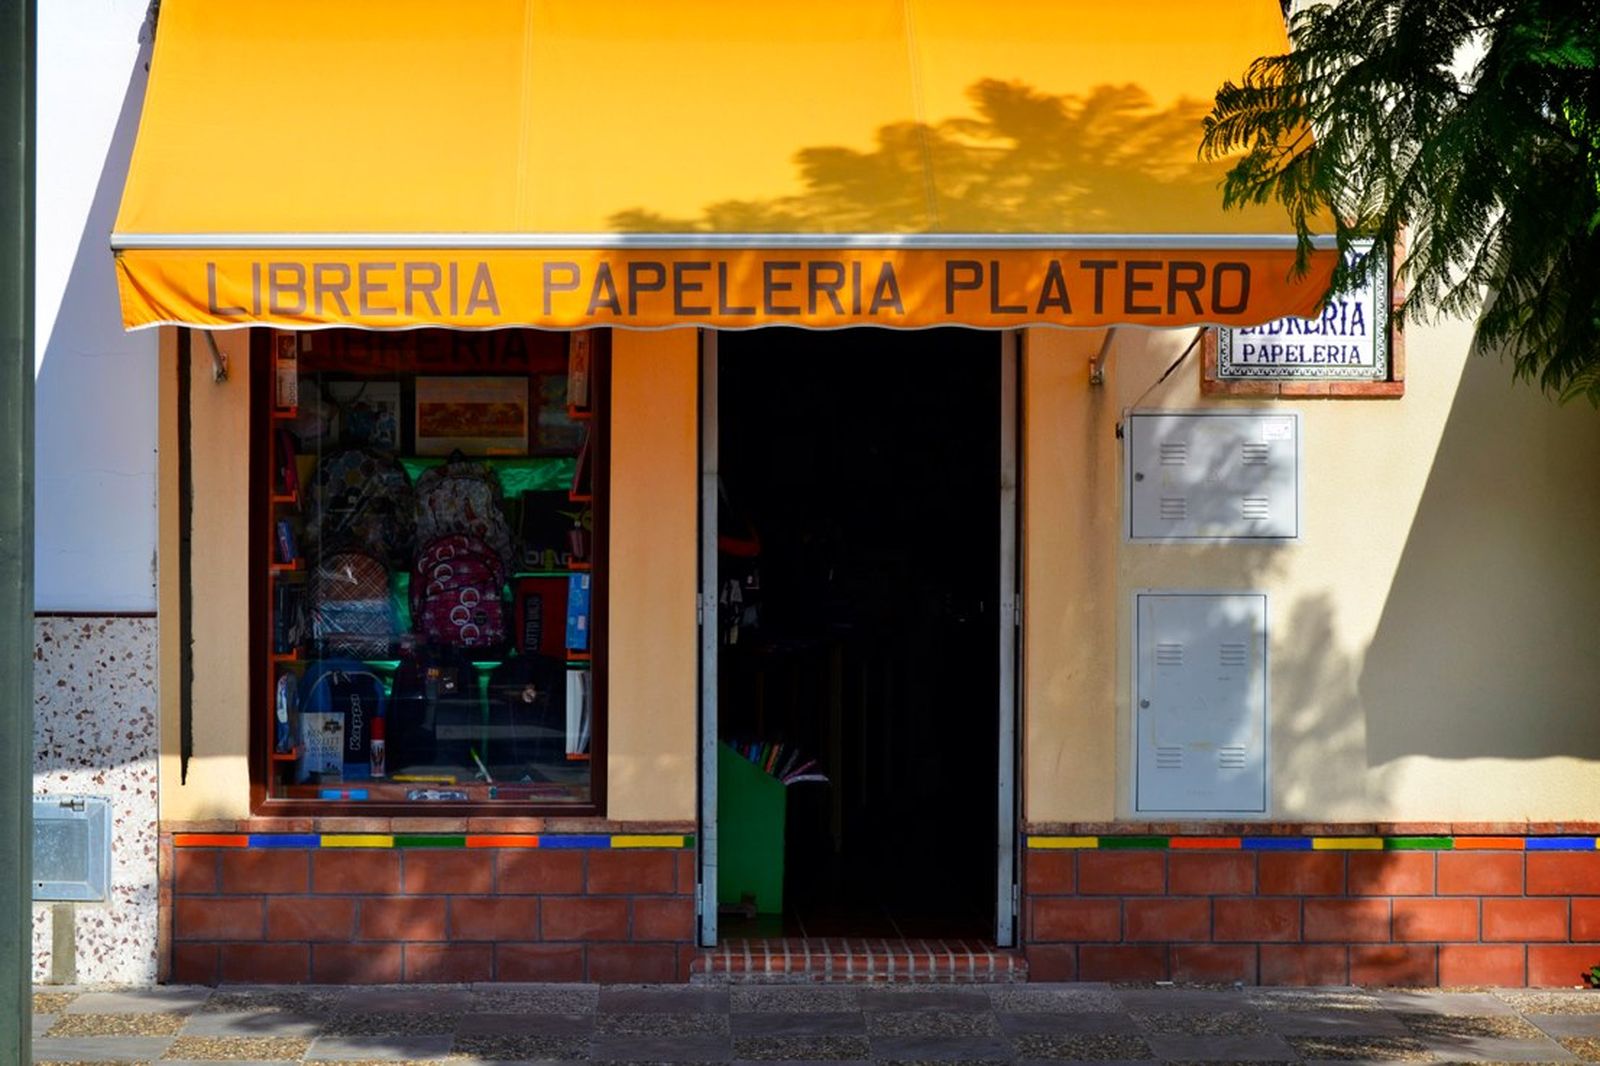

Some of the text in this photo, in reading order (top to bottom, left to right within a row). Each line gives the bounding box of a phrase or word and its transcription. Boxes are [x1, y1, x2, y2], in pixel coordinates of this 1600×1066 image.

[206, 259, 1251, 316] LIBRERIA PAPELERIA PLATERO
[1240, 301, 1365, 336] RRIA
[1242, 343, 1362, 364] PAPELERIA
[350, 693, 363, 750] Kappa
